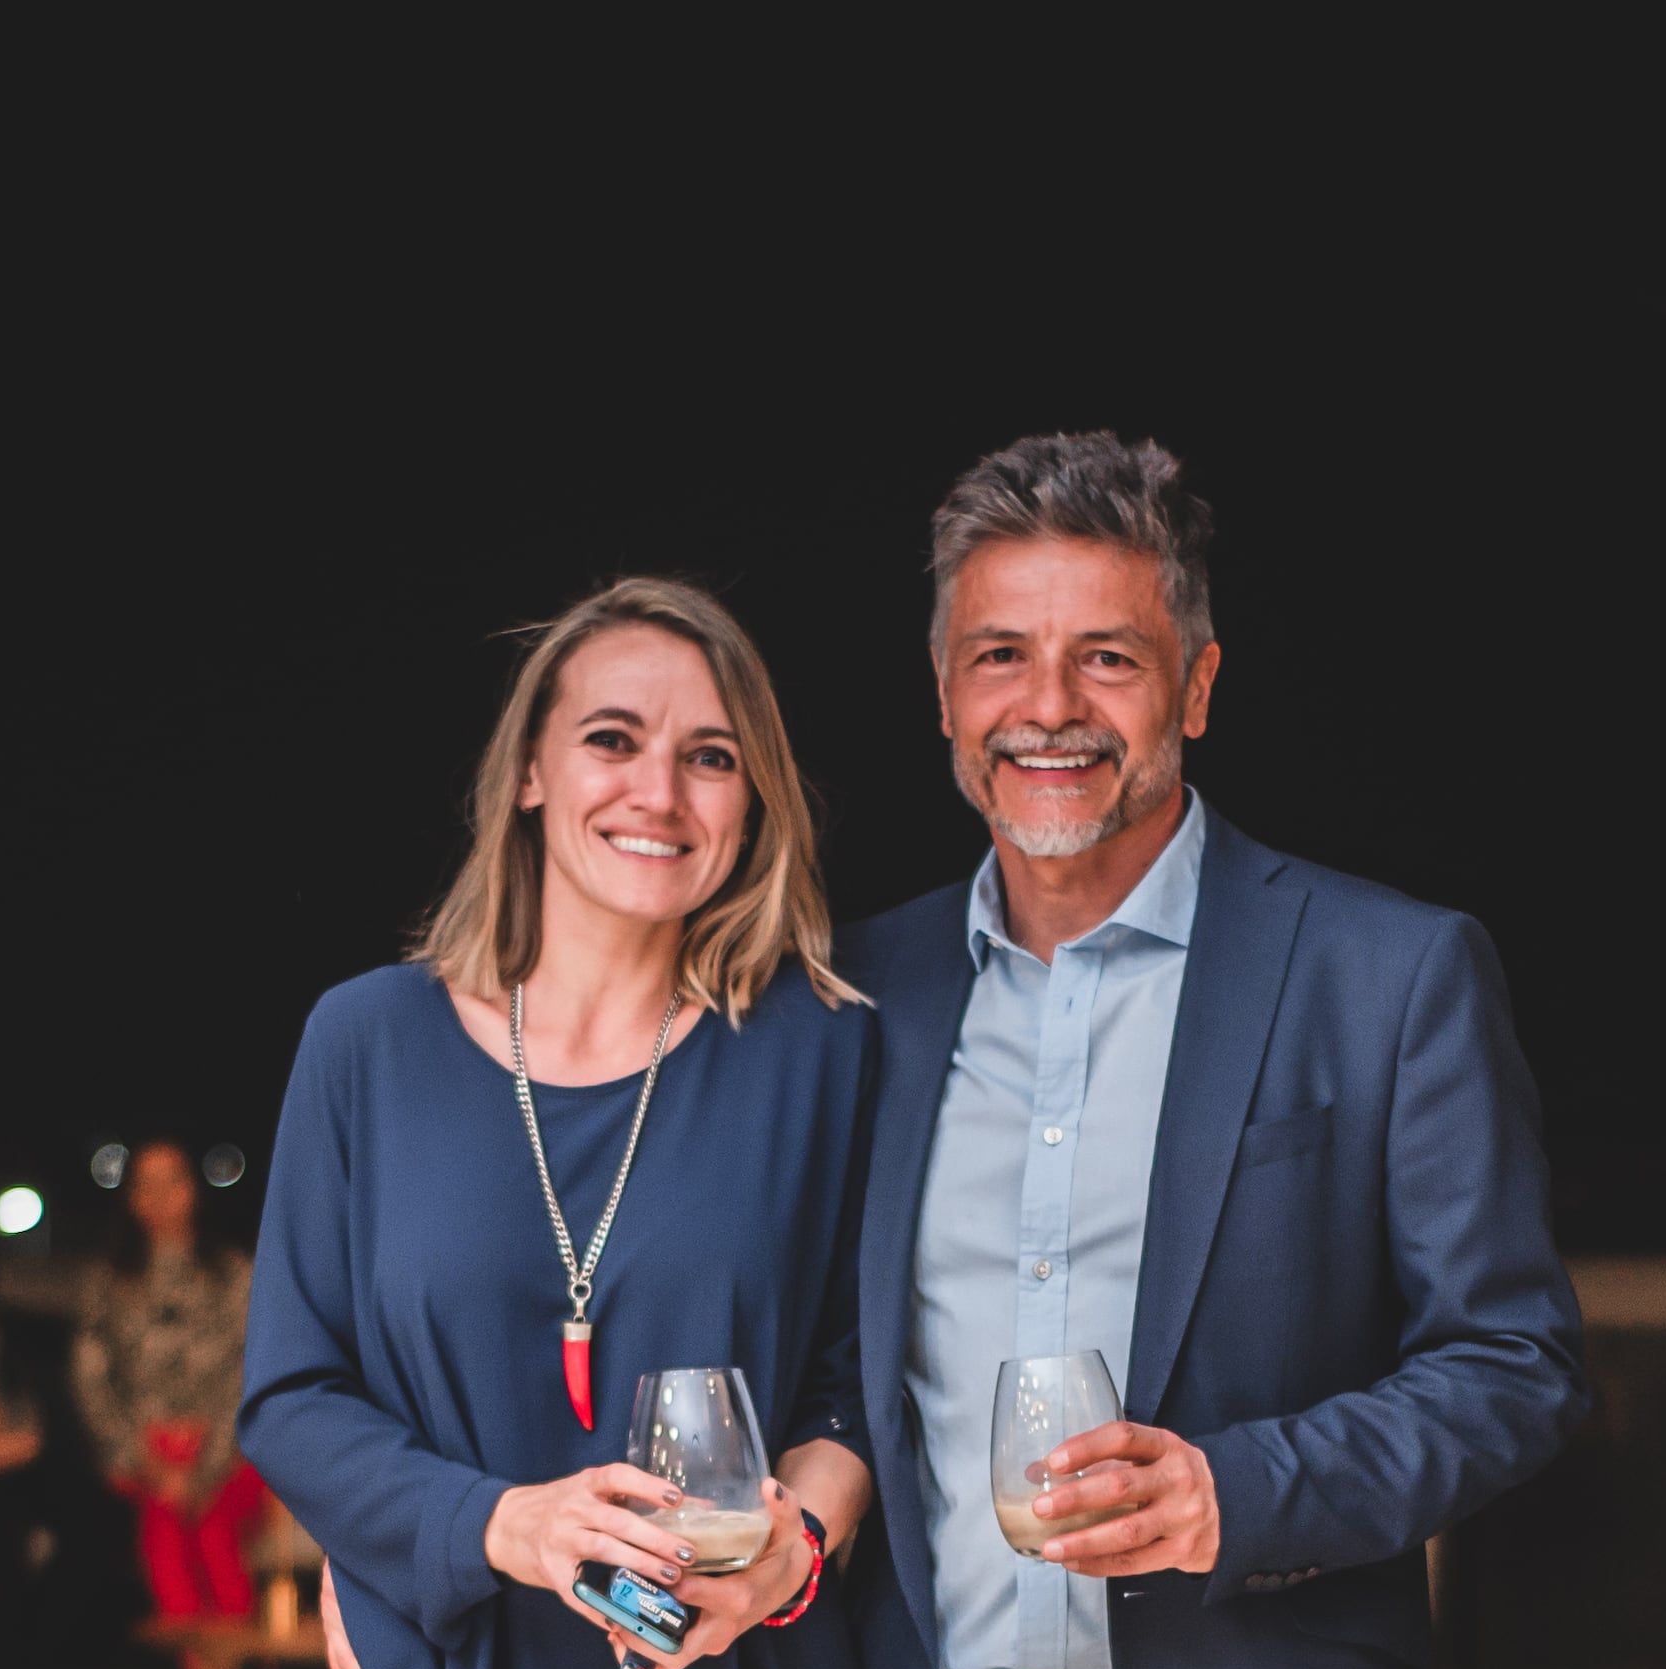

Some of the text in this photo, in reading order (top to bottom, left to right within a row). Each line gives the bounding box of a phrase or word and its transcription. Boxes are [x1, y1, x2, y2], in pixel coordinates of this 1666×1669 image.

[619, 1584, 633, 1598] 12
[639, 1597, 661, 1614] LUCKY
[660, 1609, 683, 1629] STRIKE
